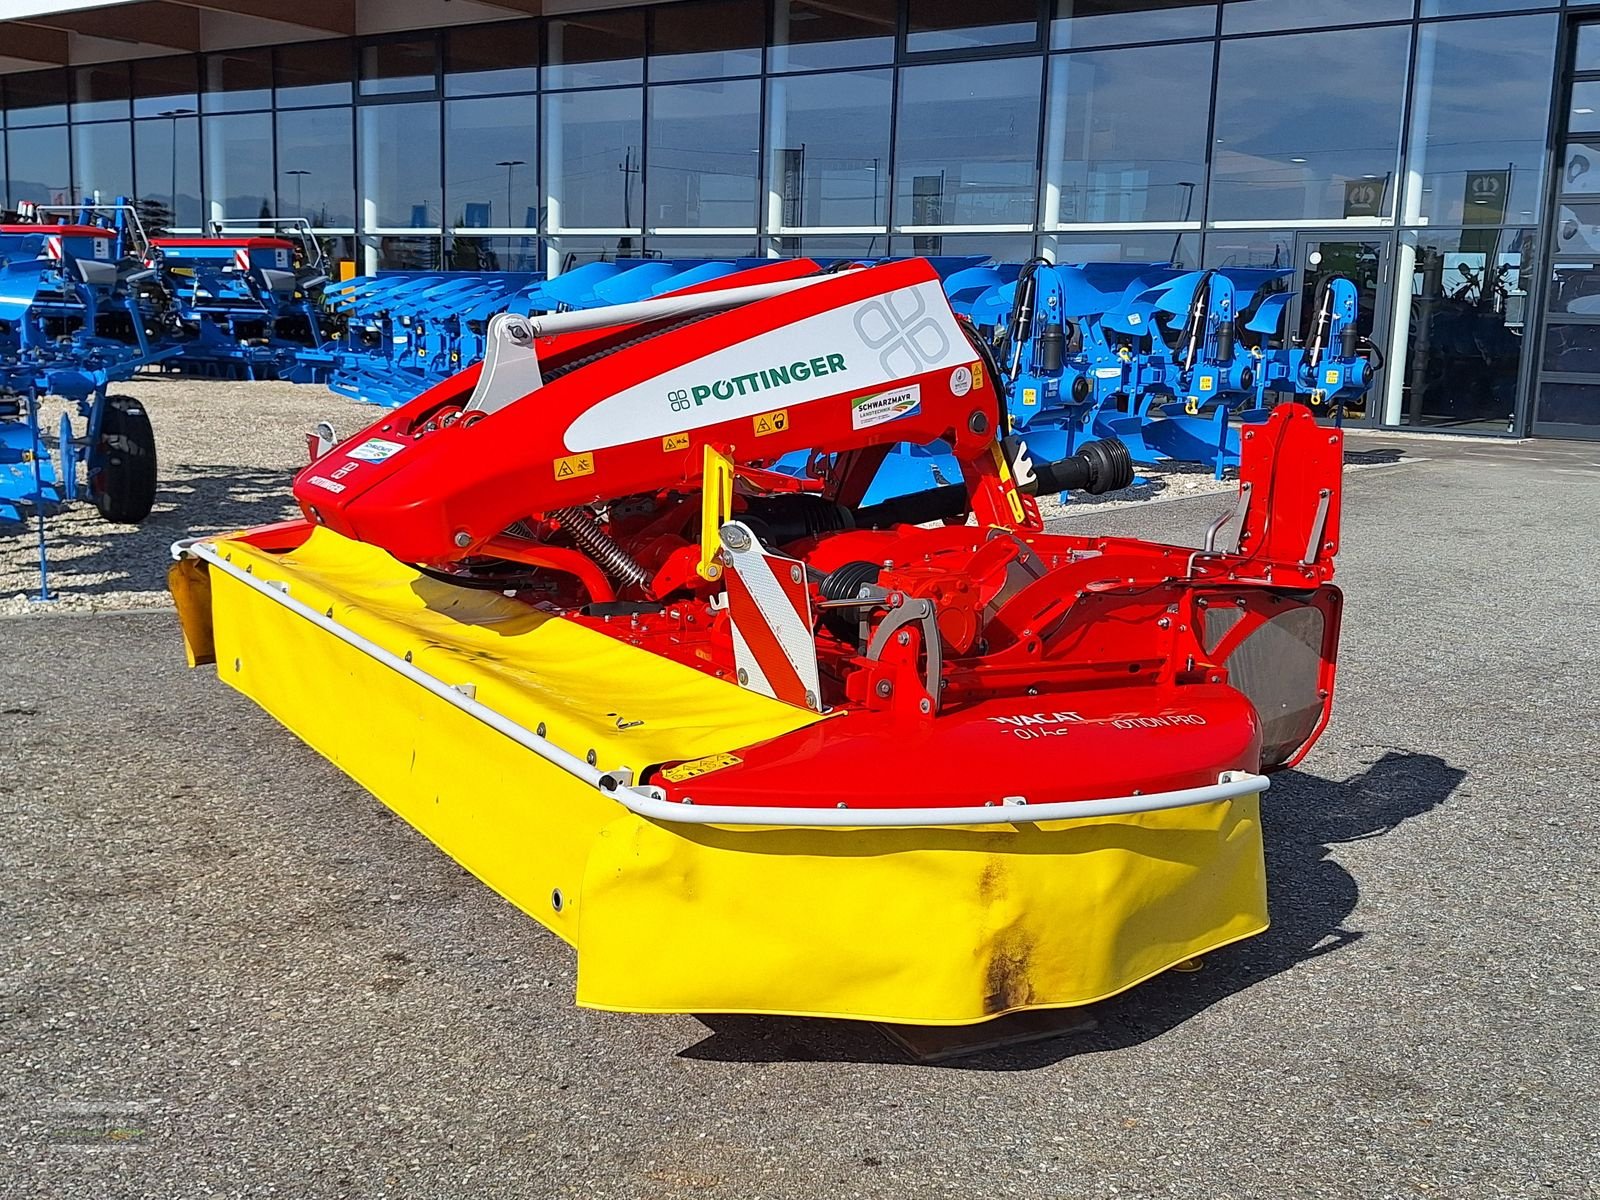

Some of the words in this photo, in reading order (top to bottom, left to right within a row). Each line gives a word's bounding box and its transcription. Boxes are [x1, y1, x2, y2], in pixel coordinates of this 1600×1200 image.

[691, 353, 847, 406] PÖTTINGER
[858, 393, 911, 412] SCHWARZMAYR
[859, 407, 891, 418] LANDTECHNIK
[1166, 714, 1207, 726] PRO
